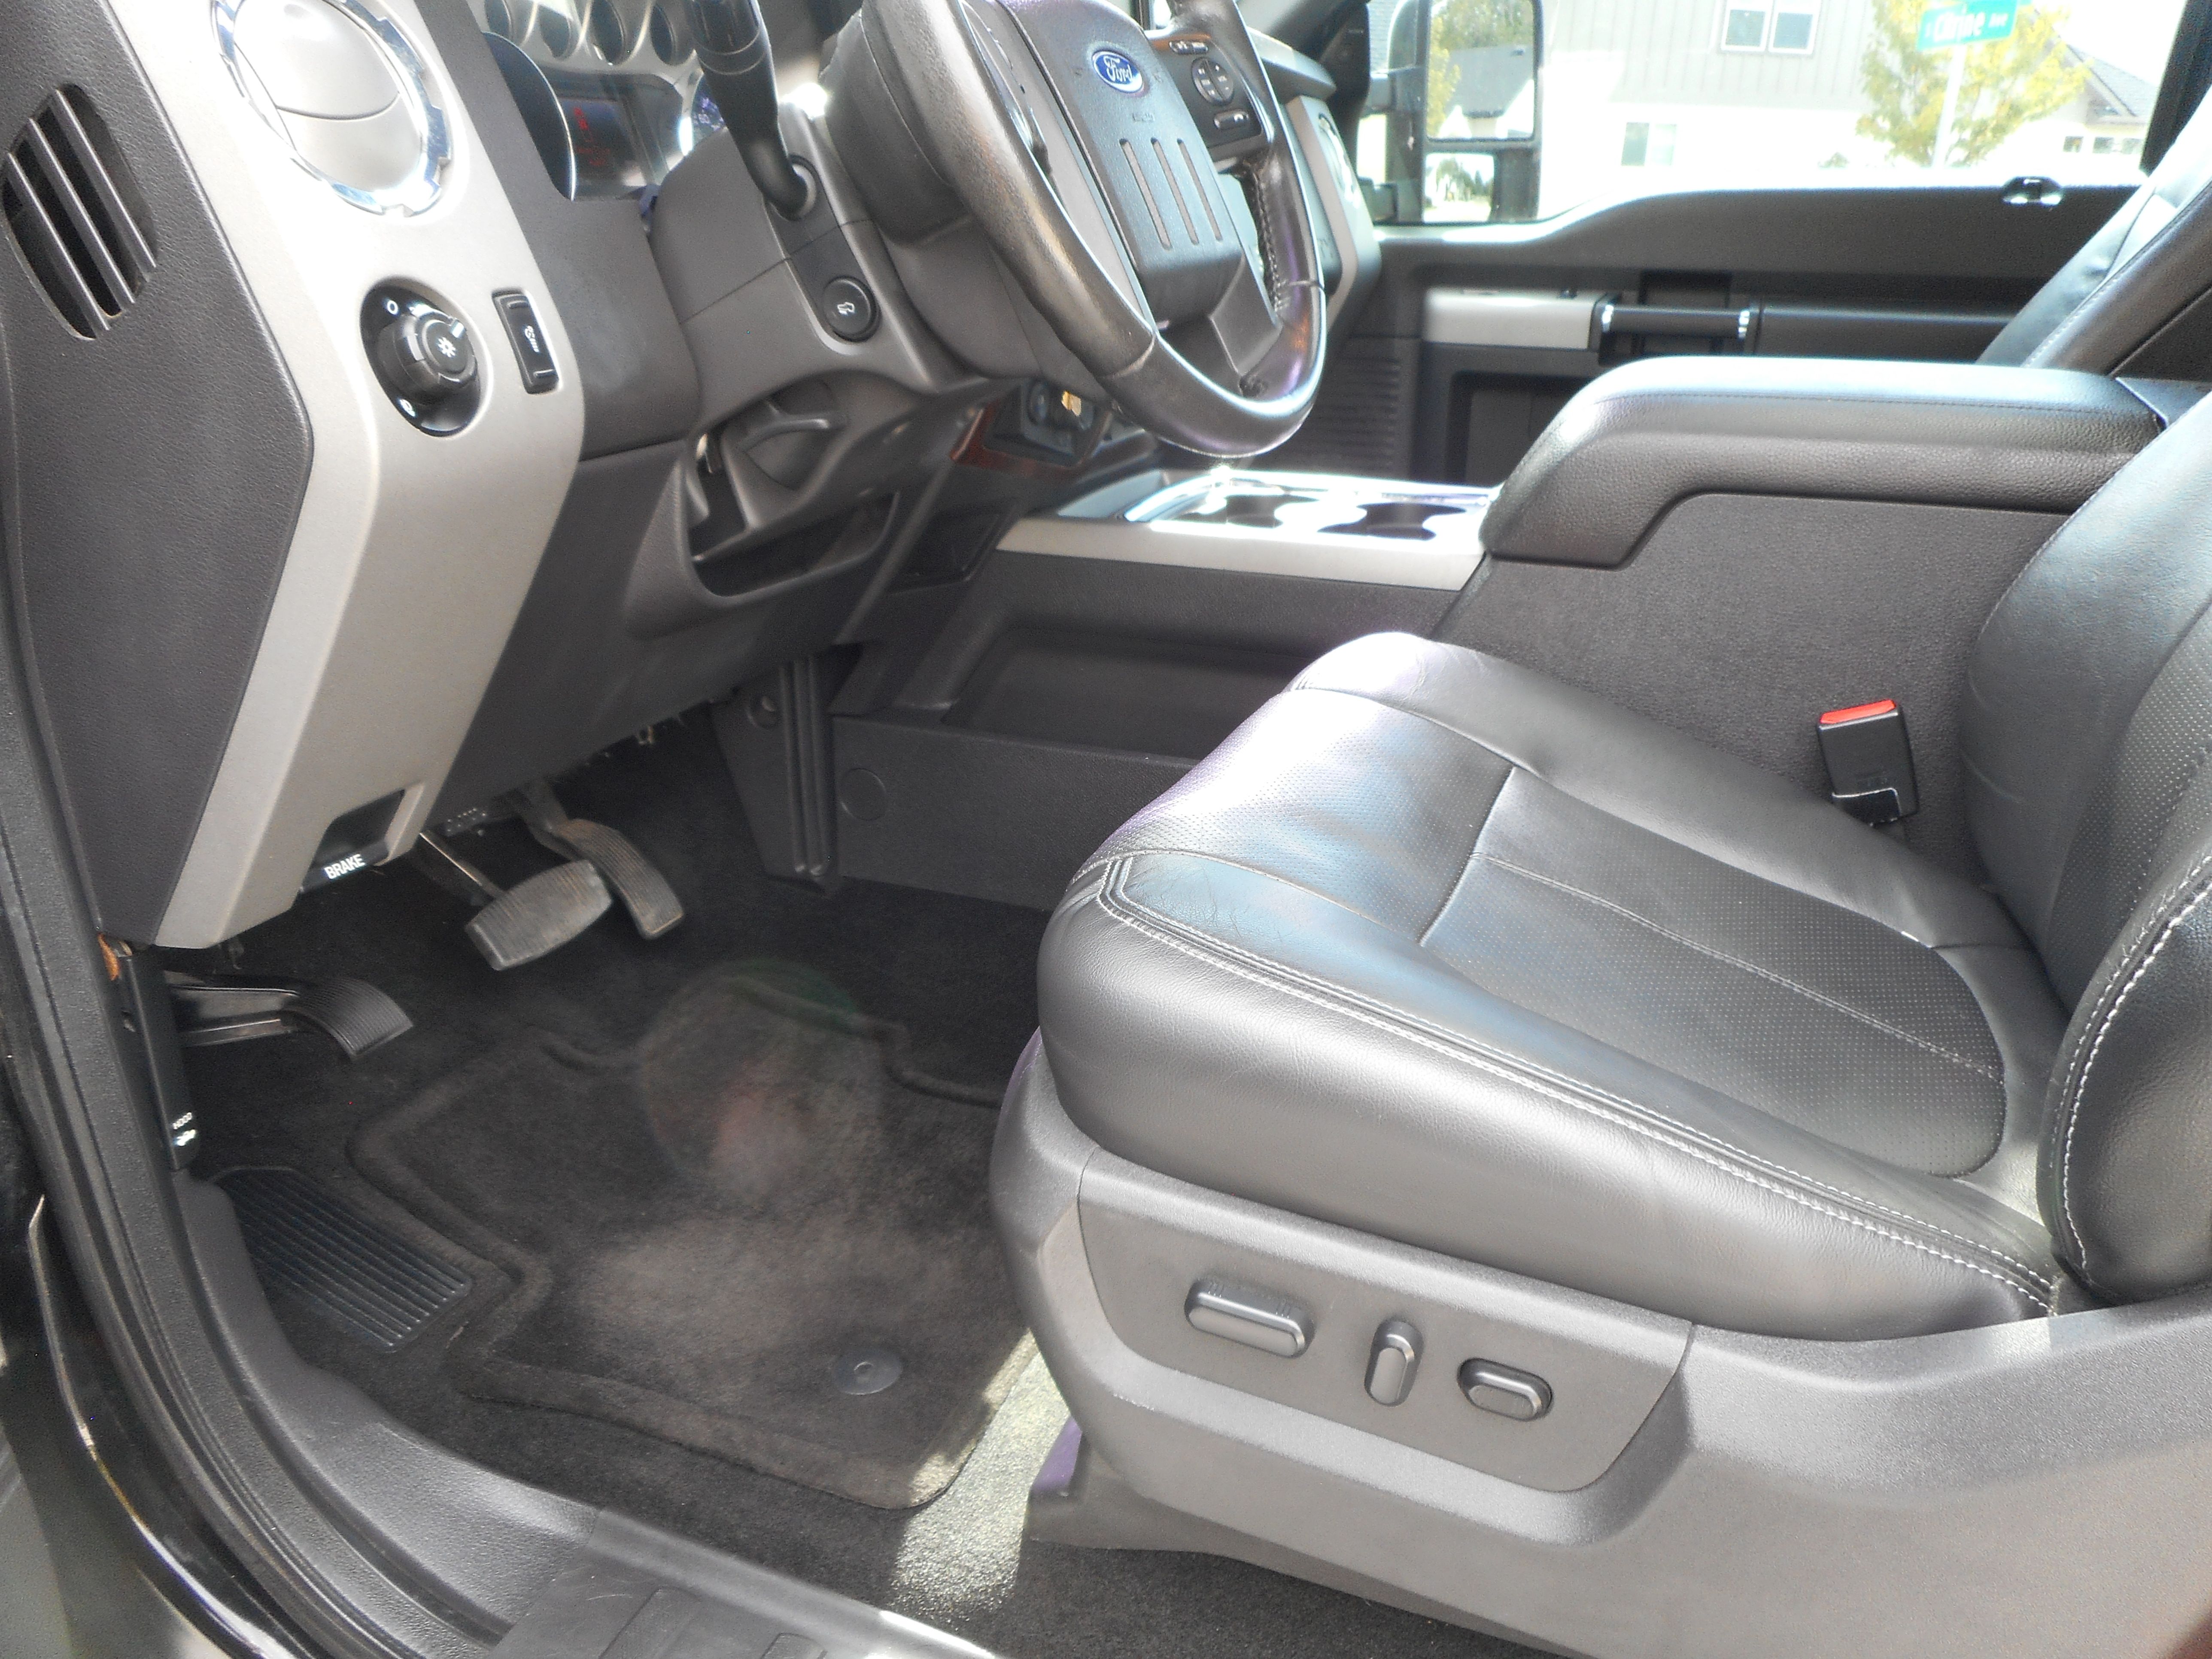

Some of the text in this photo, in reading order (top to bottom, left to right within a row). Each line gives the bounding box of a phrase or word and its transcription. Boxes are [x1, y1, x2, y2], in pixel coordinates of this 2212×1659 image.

[1103, 55, 1133, 82] Ford
[324, 853, 366, 879] BRAKE
[172, 1112, 192, 1130] HOOD
